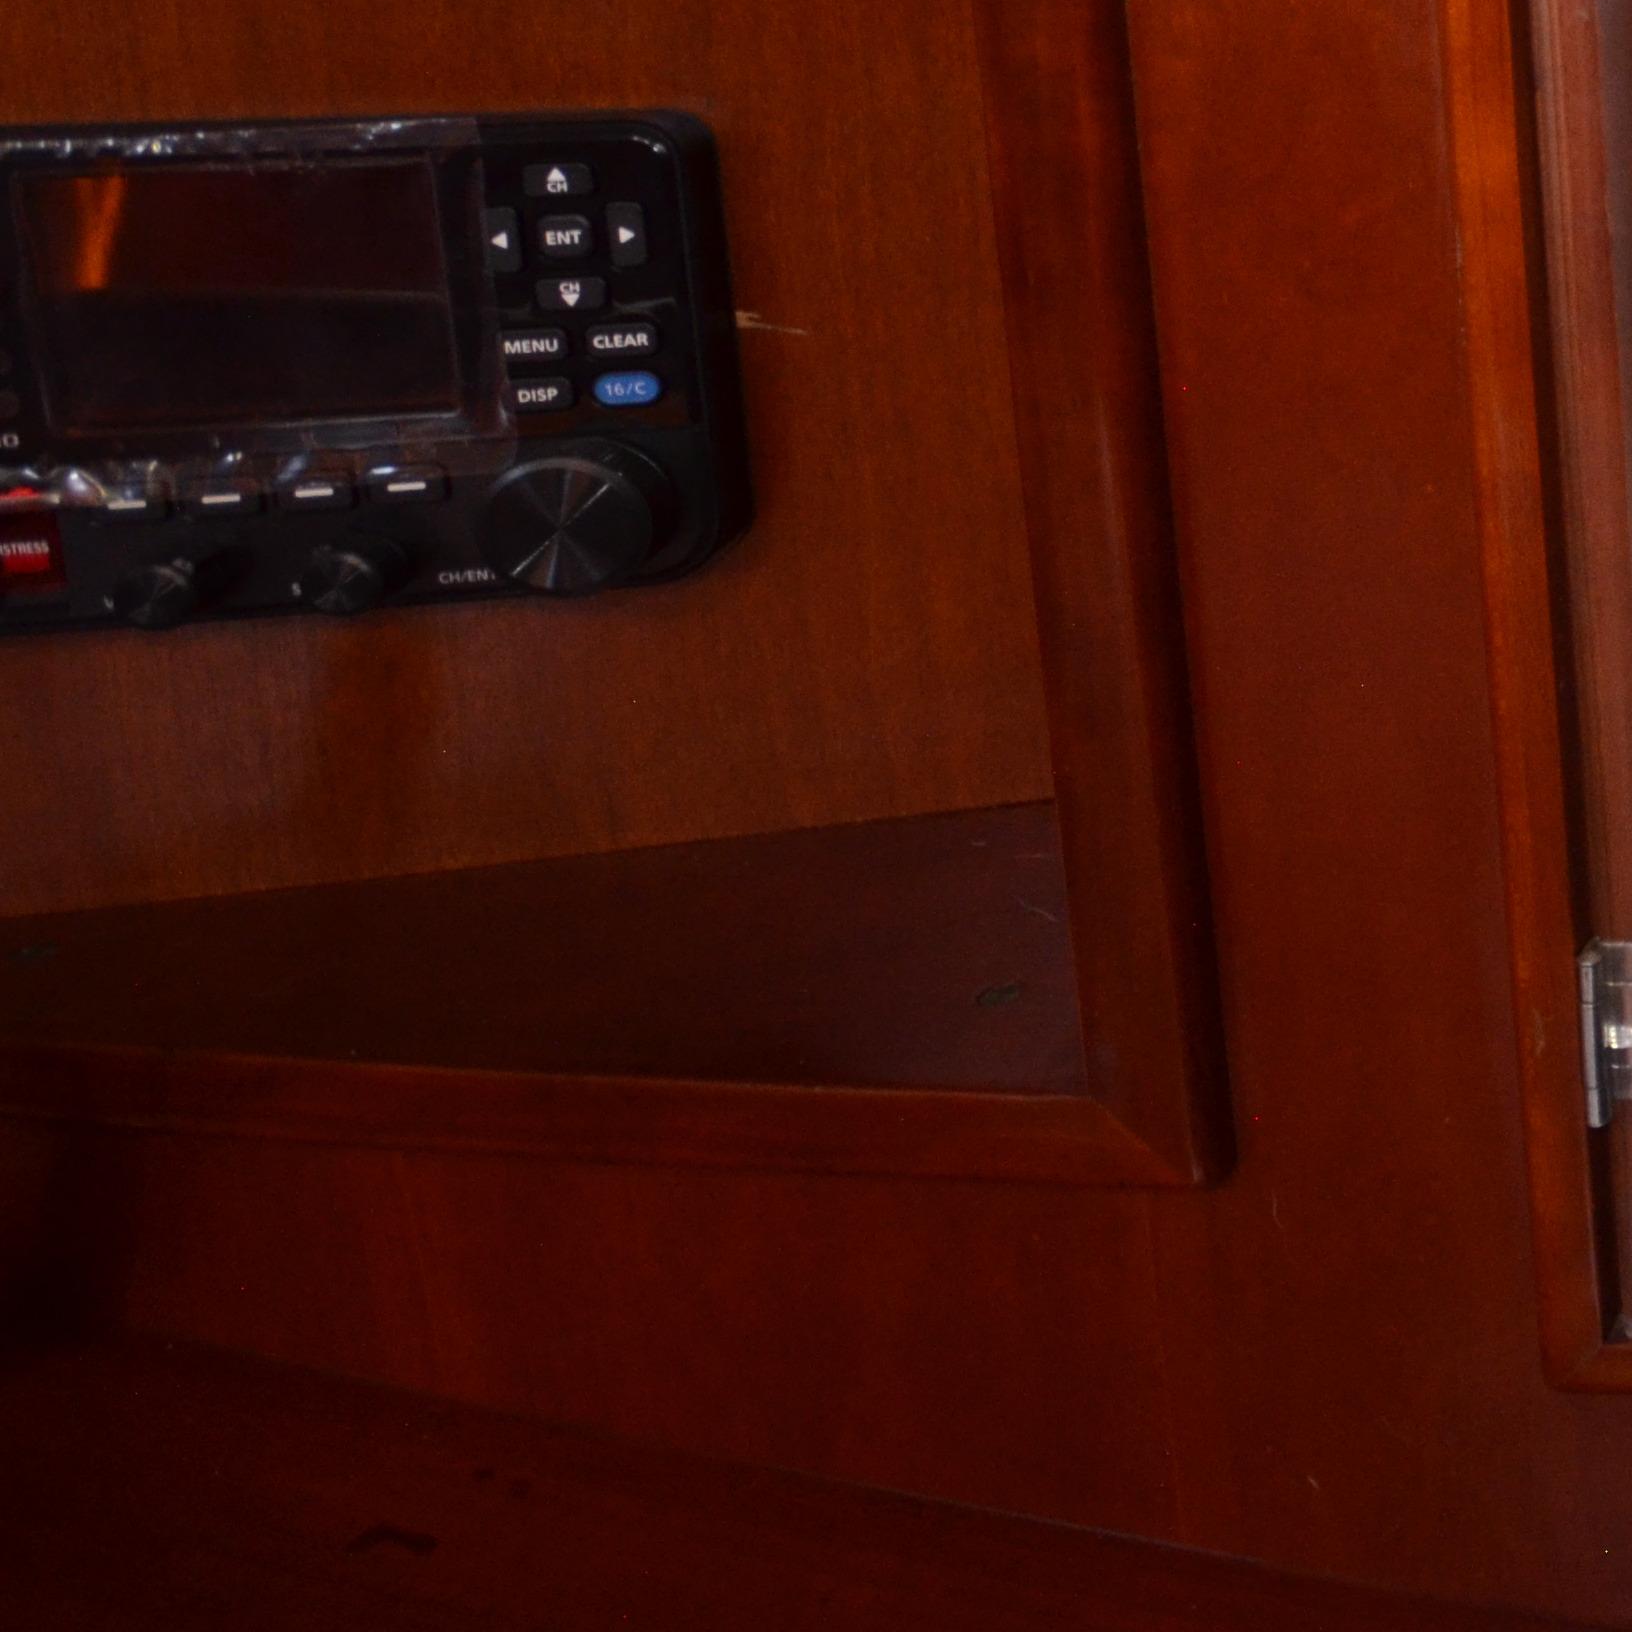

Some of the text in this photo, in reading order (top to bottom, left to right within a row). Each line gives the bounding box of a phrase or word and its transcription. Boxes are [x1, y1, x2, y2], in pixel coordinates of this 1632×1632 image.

[545, 229, 581, 245] ENT
[504, 338, 558, 354] MENU
[593, 333, 648, 349] CLEAR
[517, 388, 558, 403] DISP
[604, 381, 646, 397] 16/C
